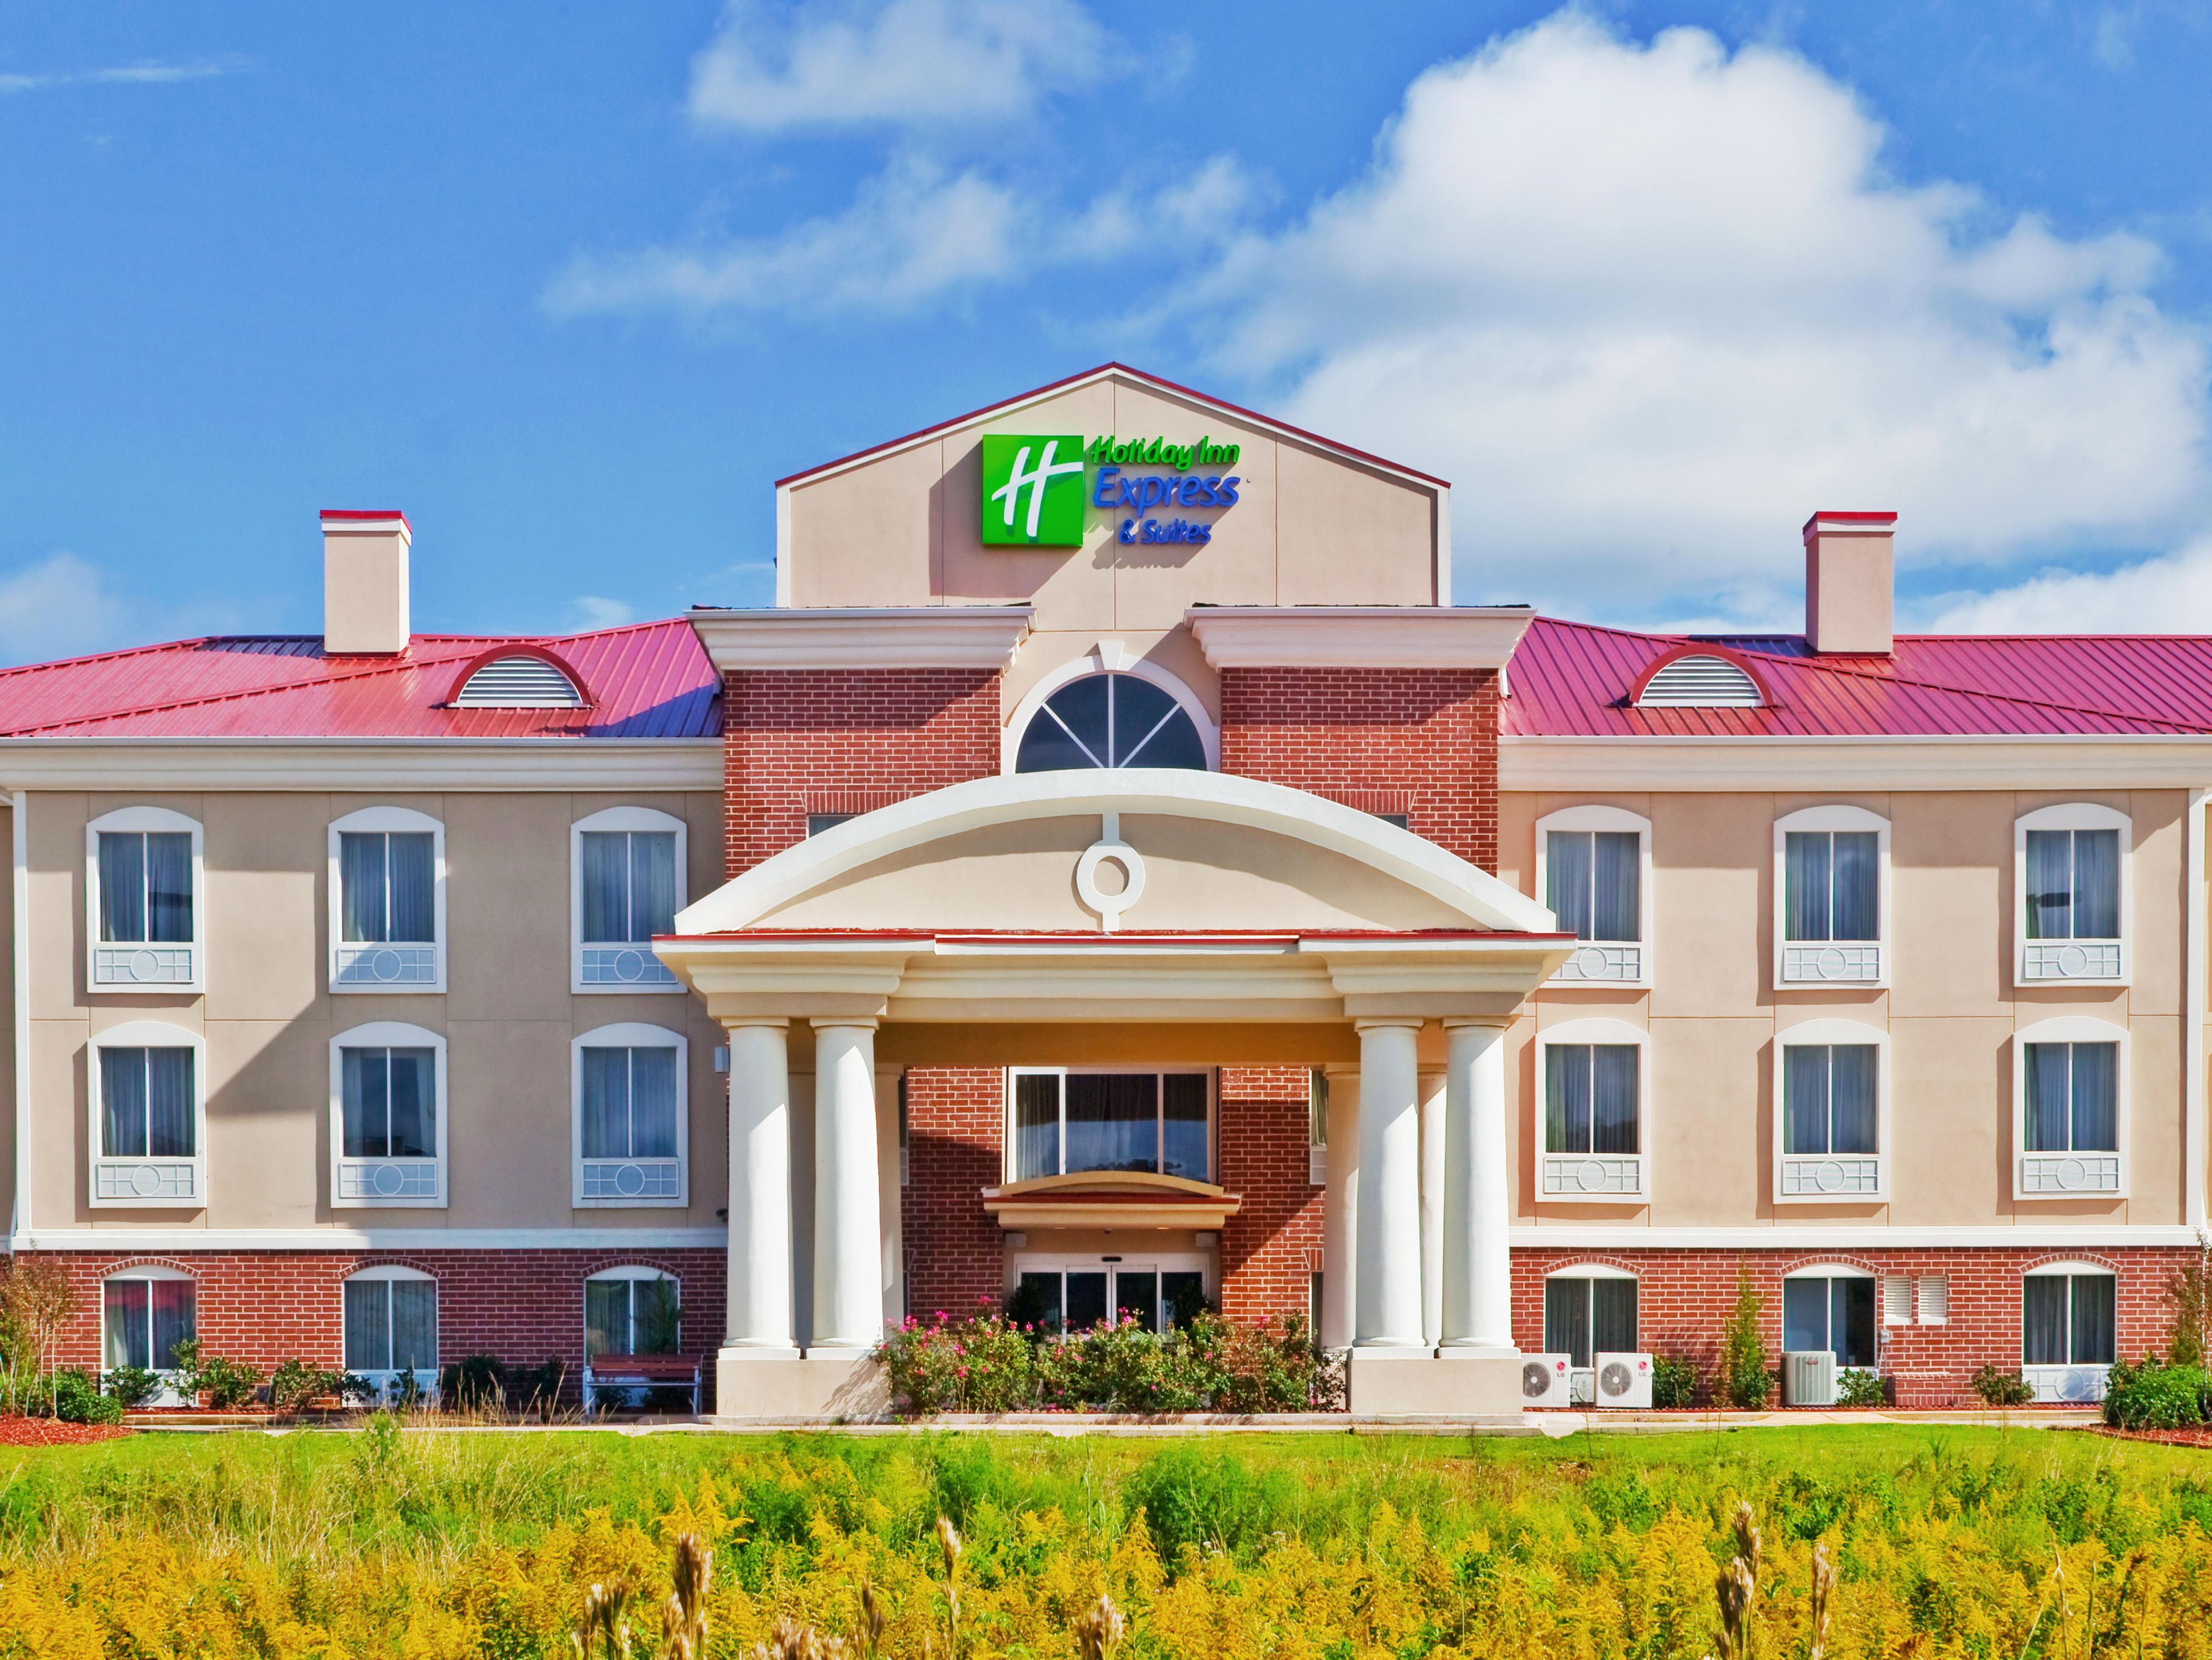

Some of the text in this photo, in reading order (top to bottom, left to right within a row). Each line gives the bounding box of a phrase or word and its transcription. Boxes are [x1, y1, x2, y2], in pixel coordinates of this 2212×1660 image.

[1092, 435, 1240, 471] Holiday Inn
[1092, 467, 1240, 518] Express
[1118, 518, 1212, 544] & Suites
